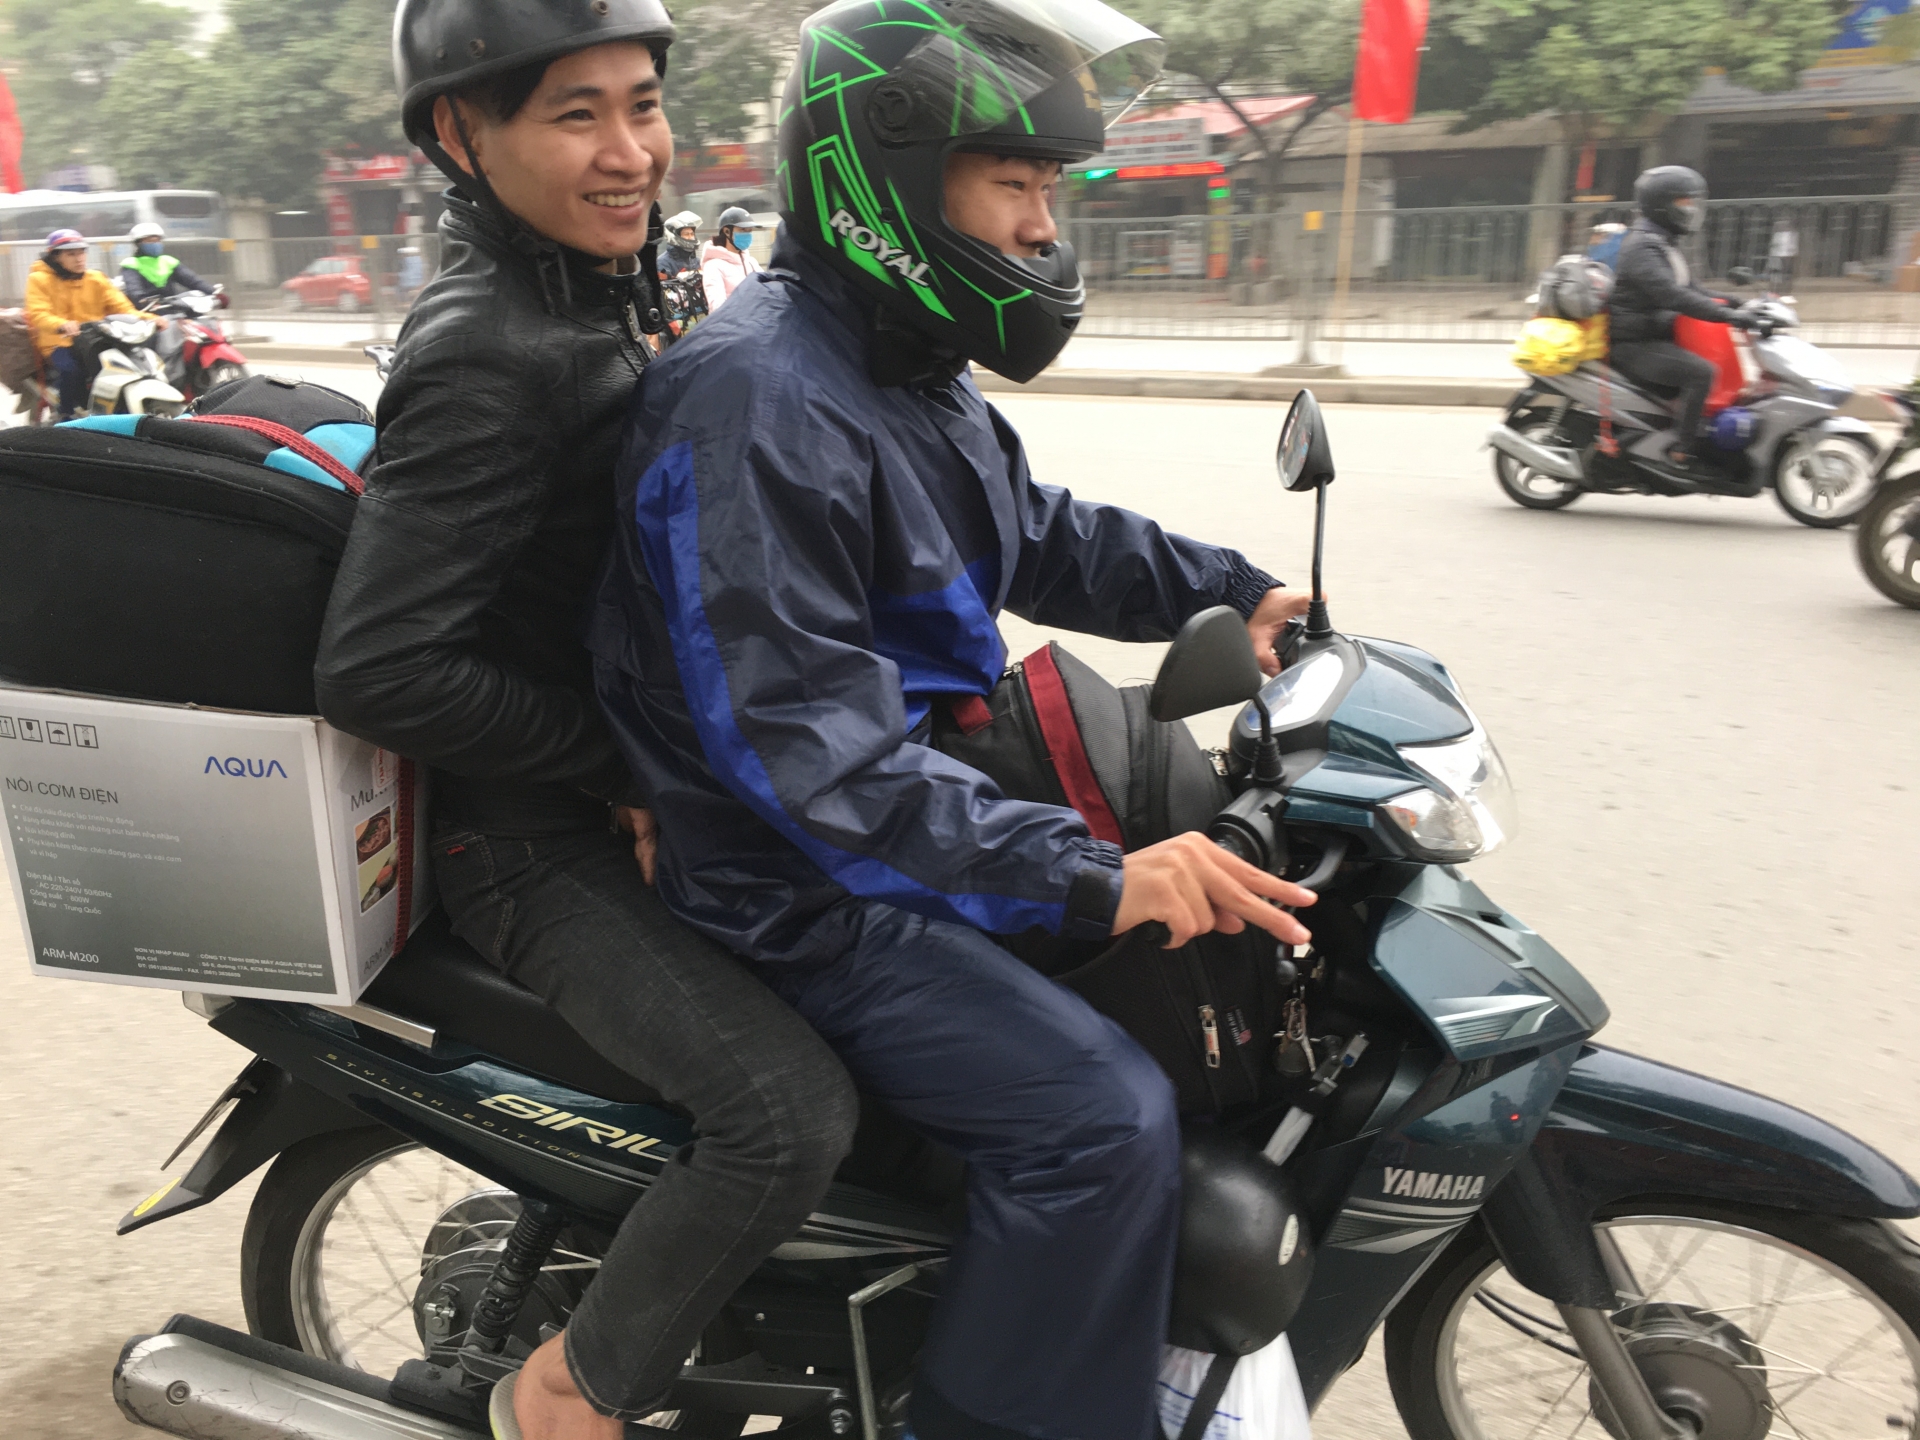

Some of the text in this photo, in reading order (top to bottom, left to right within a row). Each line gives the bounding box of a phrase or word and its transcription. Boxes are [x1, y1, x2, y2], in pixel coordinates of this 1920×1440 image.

[829, 209, 930, 287] ROYAL
[204, 755, 288, 779] AQUA
[38, 782, 75, 799] CƠM
[79, 787, 119, 805] ĐIỆN
[42, 946, 99, 964] ARM-M200
[1382, 1166, 1486, 1200] YAMAHA
